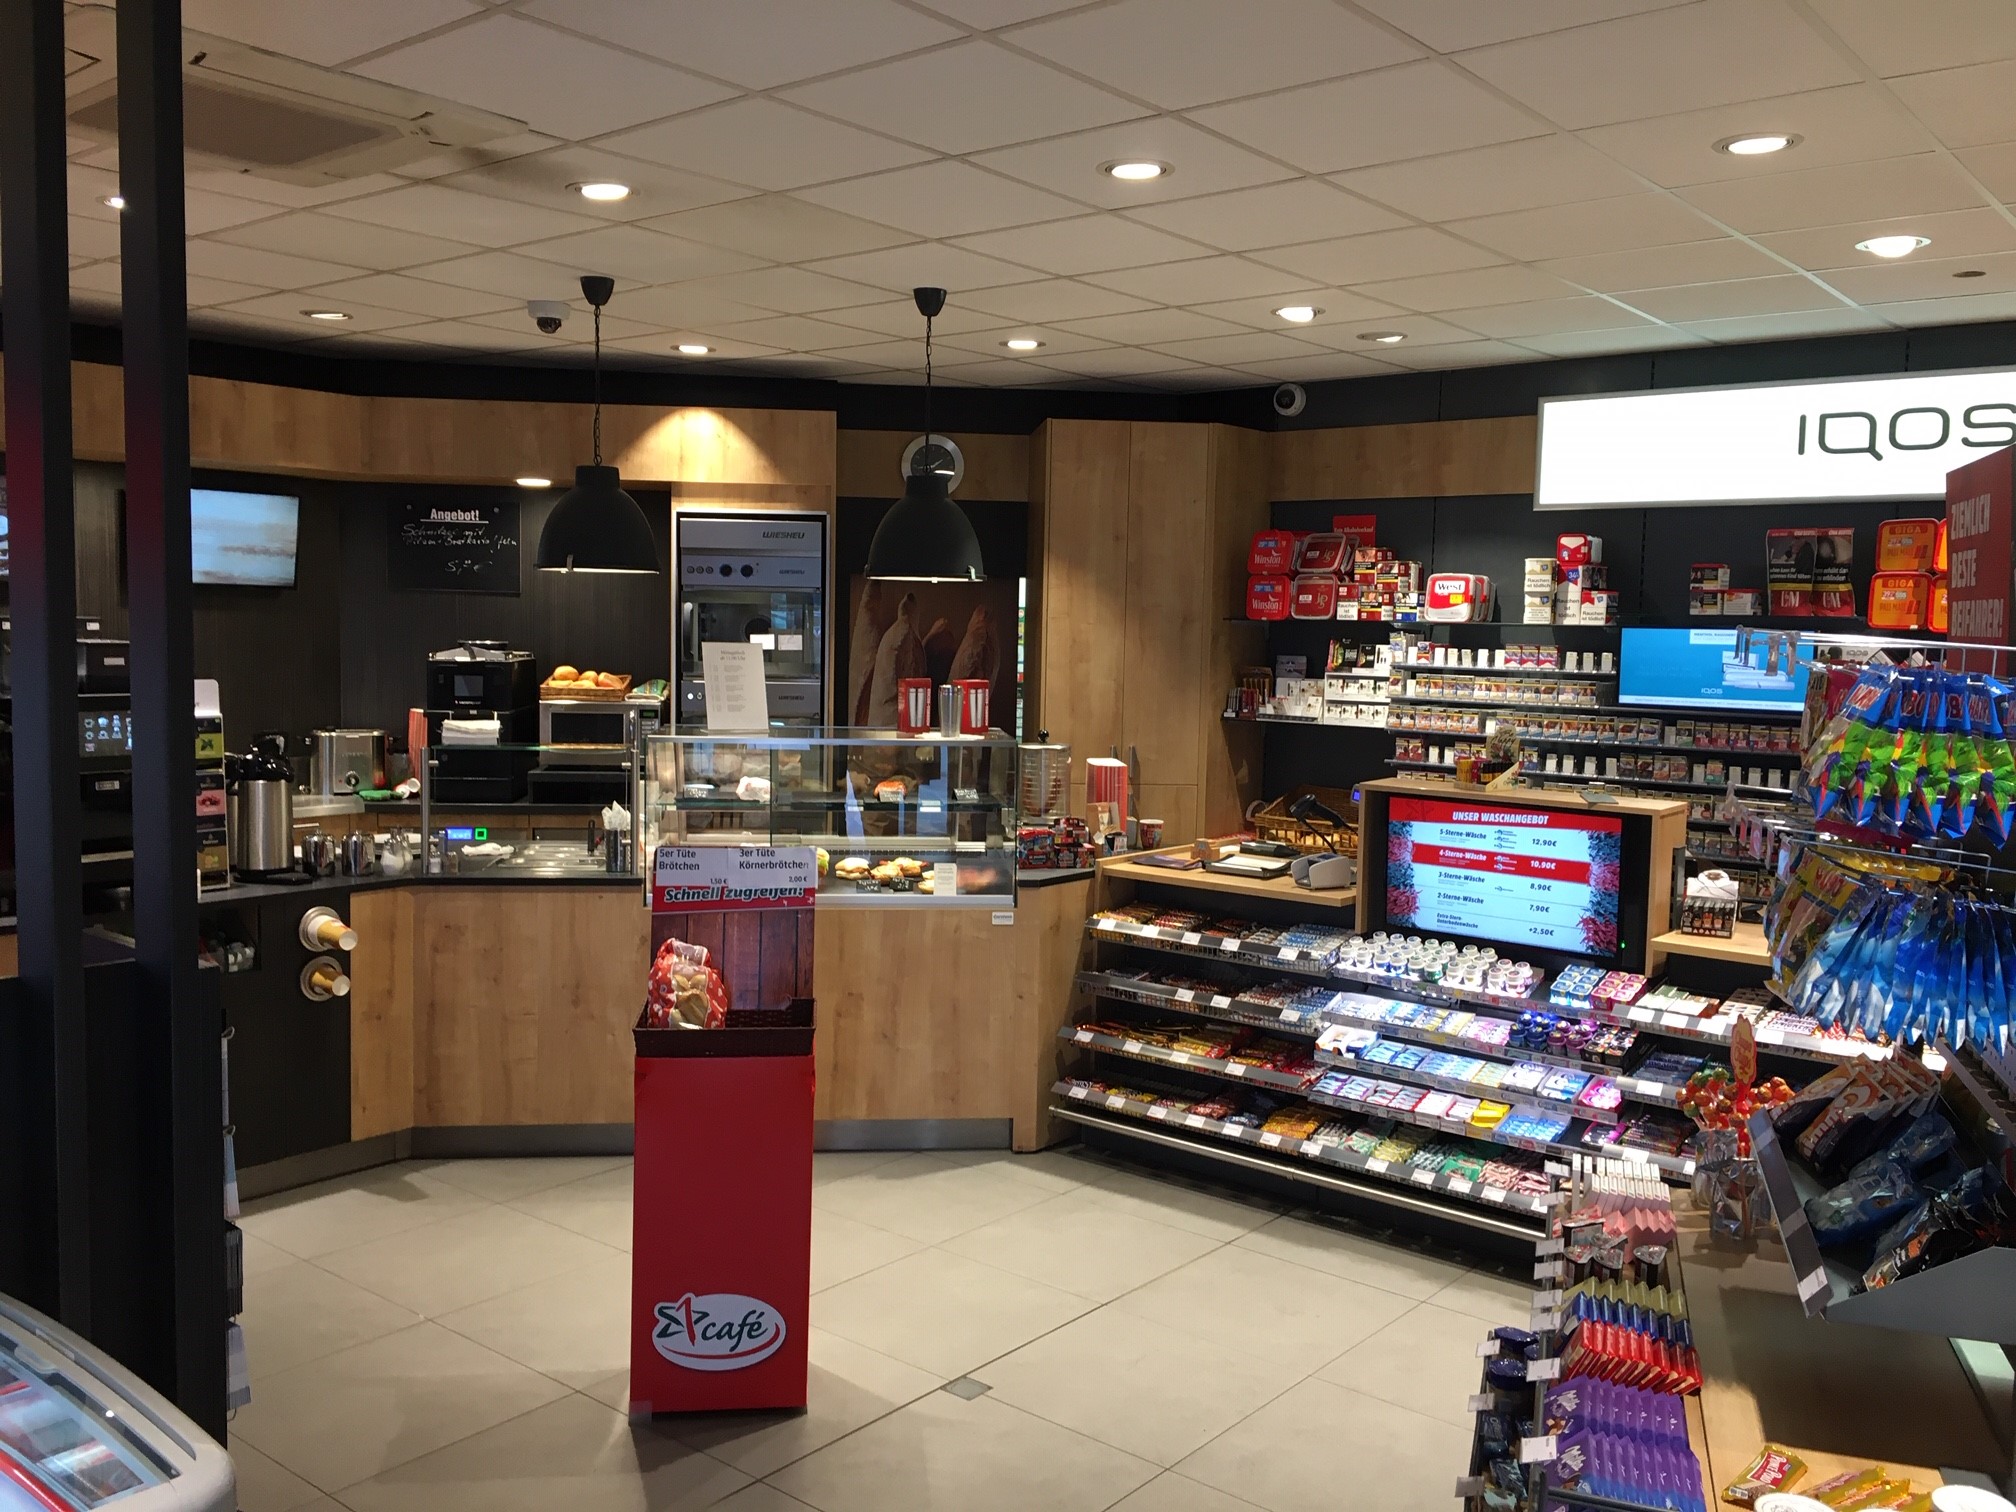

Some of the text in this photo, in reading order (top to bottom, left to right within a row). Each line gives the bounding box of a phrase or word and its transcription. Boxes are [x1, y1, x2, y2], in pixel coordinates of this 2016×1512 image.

[1798, 403, 2016, 461] IQOS
[430, 508, 480, 521] Angebot!
[1951, 493, 1991, 540] ZIEMLICH
[1895, 525, 1922, 534] GIGA
[1254, 554, 1281, 565] Winston
[1951, 549, 1977, 588] BESTE
[1438, 583, 1462, 591] West
[1888, 579, 1914, 588] GIGA
[1252, 598, 1279, 610] Winston
[1951, 599, 2004, 638] BEIFAHRER!
[1452, 811, 1549, 825] UNSER WASCHANGEBOT
[1439, 828, 1487, 839] 5-Sterne-Wäsche
[1532, 838, 1557, 847] 12,90€
[659, 849, 697, 858] 5er Tüte
[739, 848, 776, 857] 3er Tüte
[1439, 849, 1487, 861] 4-Sterne-Wäsche
[659, 861, 700, 871] Brötchen
[739, 860, 809, 870] Körnerbrötchen
[1530, 860, 1556, 869] 10,90€
[1438, 871, 1485, 883] 3-Sterne-Wäsche
[1530, 883, 1552, 892] 8,90€
[664, 886, 722, 902] Schnell
[1437, 892, 1484, 904] 2-Sterne-Wäsche
[1529, 904, 1550, 913] 7,90€
[1528, 927, 1554, 937] +2,50€
[701, 1310, 768, 1352] café
